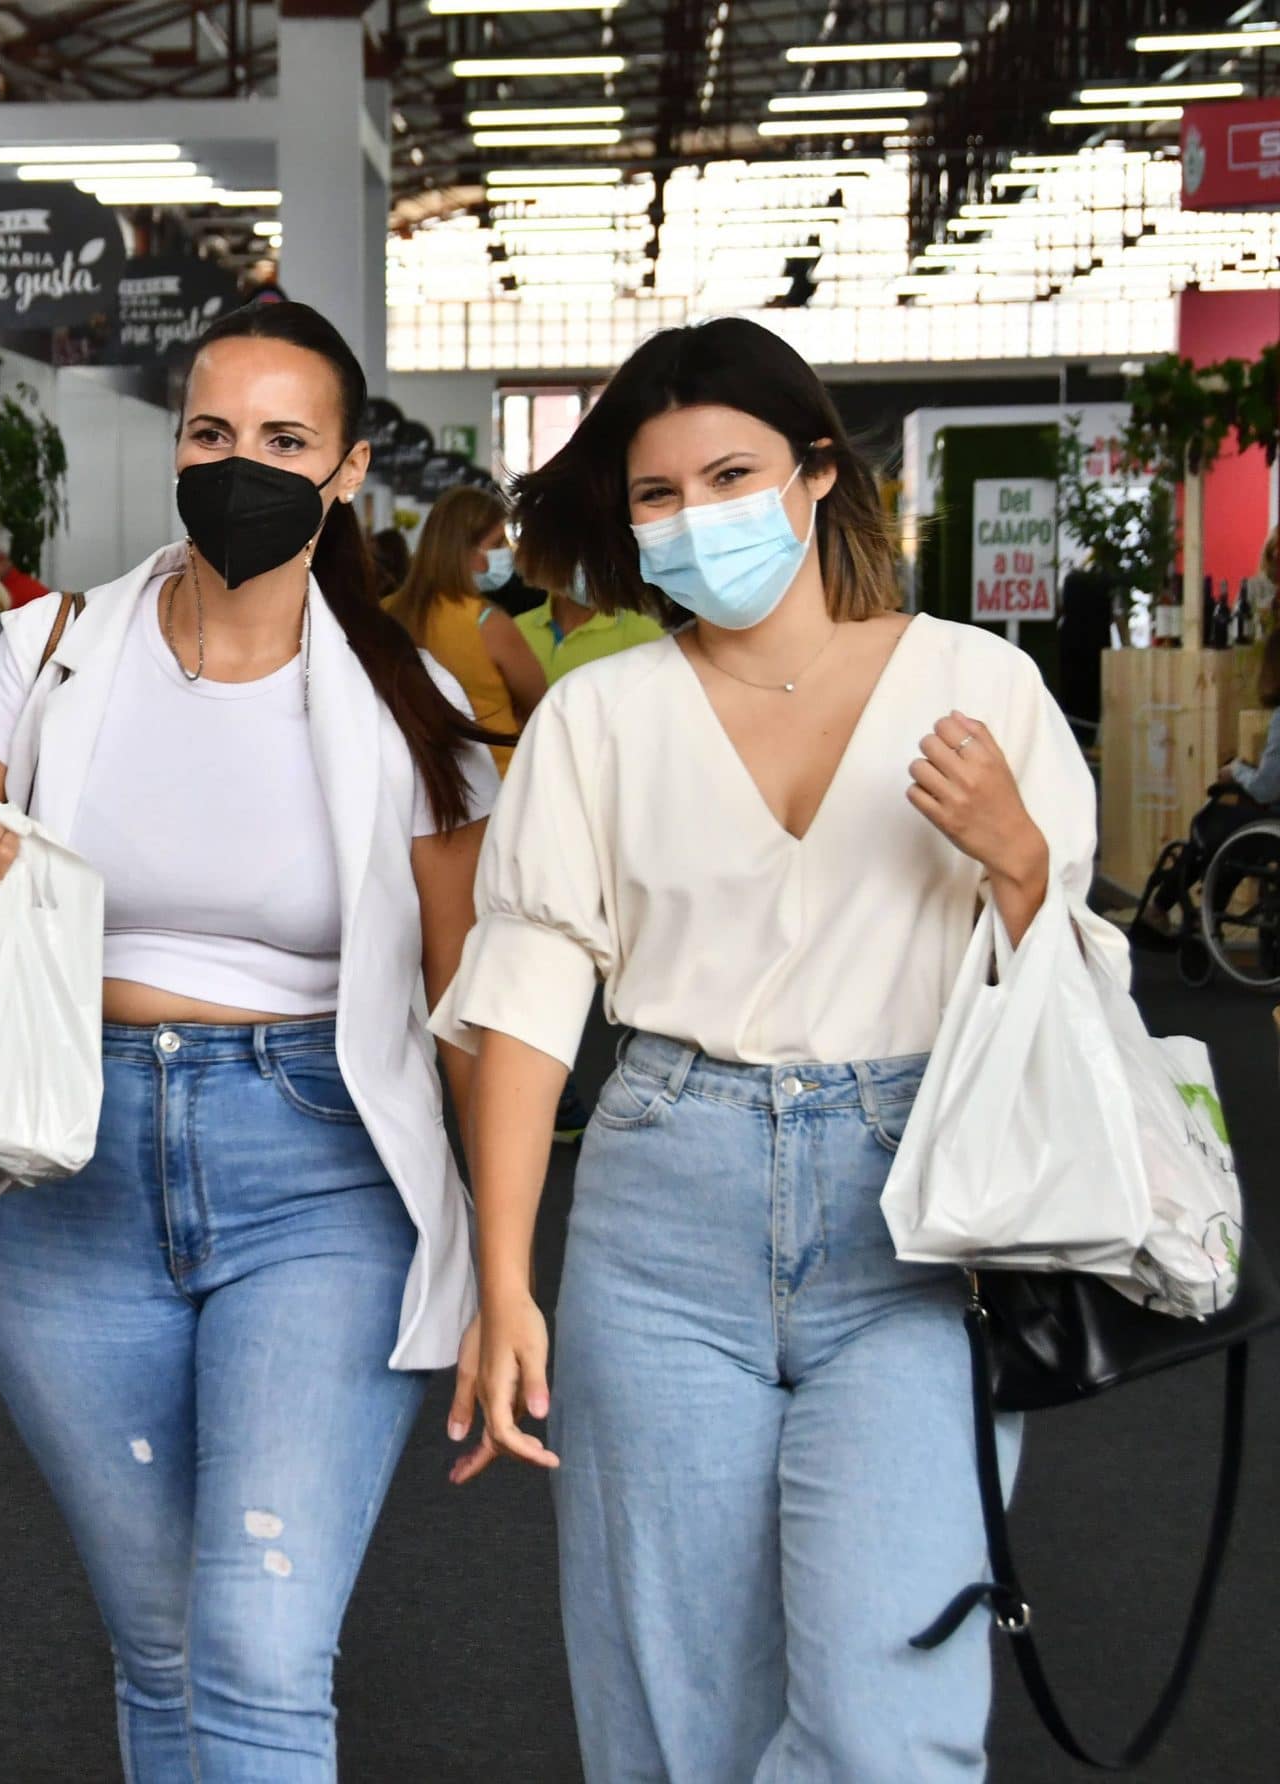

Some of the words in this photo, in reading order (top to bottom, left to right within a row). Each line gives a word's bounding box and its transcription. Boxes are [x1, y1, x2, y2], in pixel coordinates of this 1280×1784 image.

[15, 250, 102, 314] gusta
[999, 486, 1032, 513] Del
[977, 520, 1053, 547] CAMPO
[993, 554, 1007, 573] a
[1013, 551, 1034, 573] tu
[976, 579, 1050, 613] MESA
